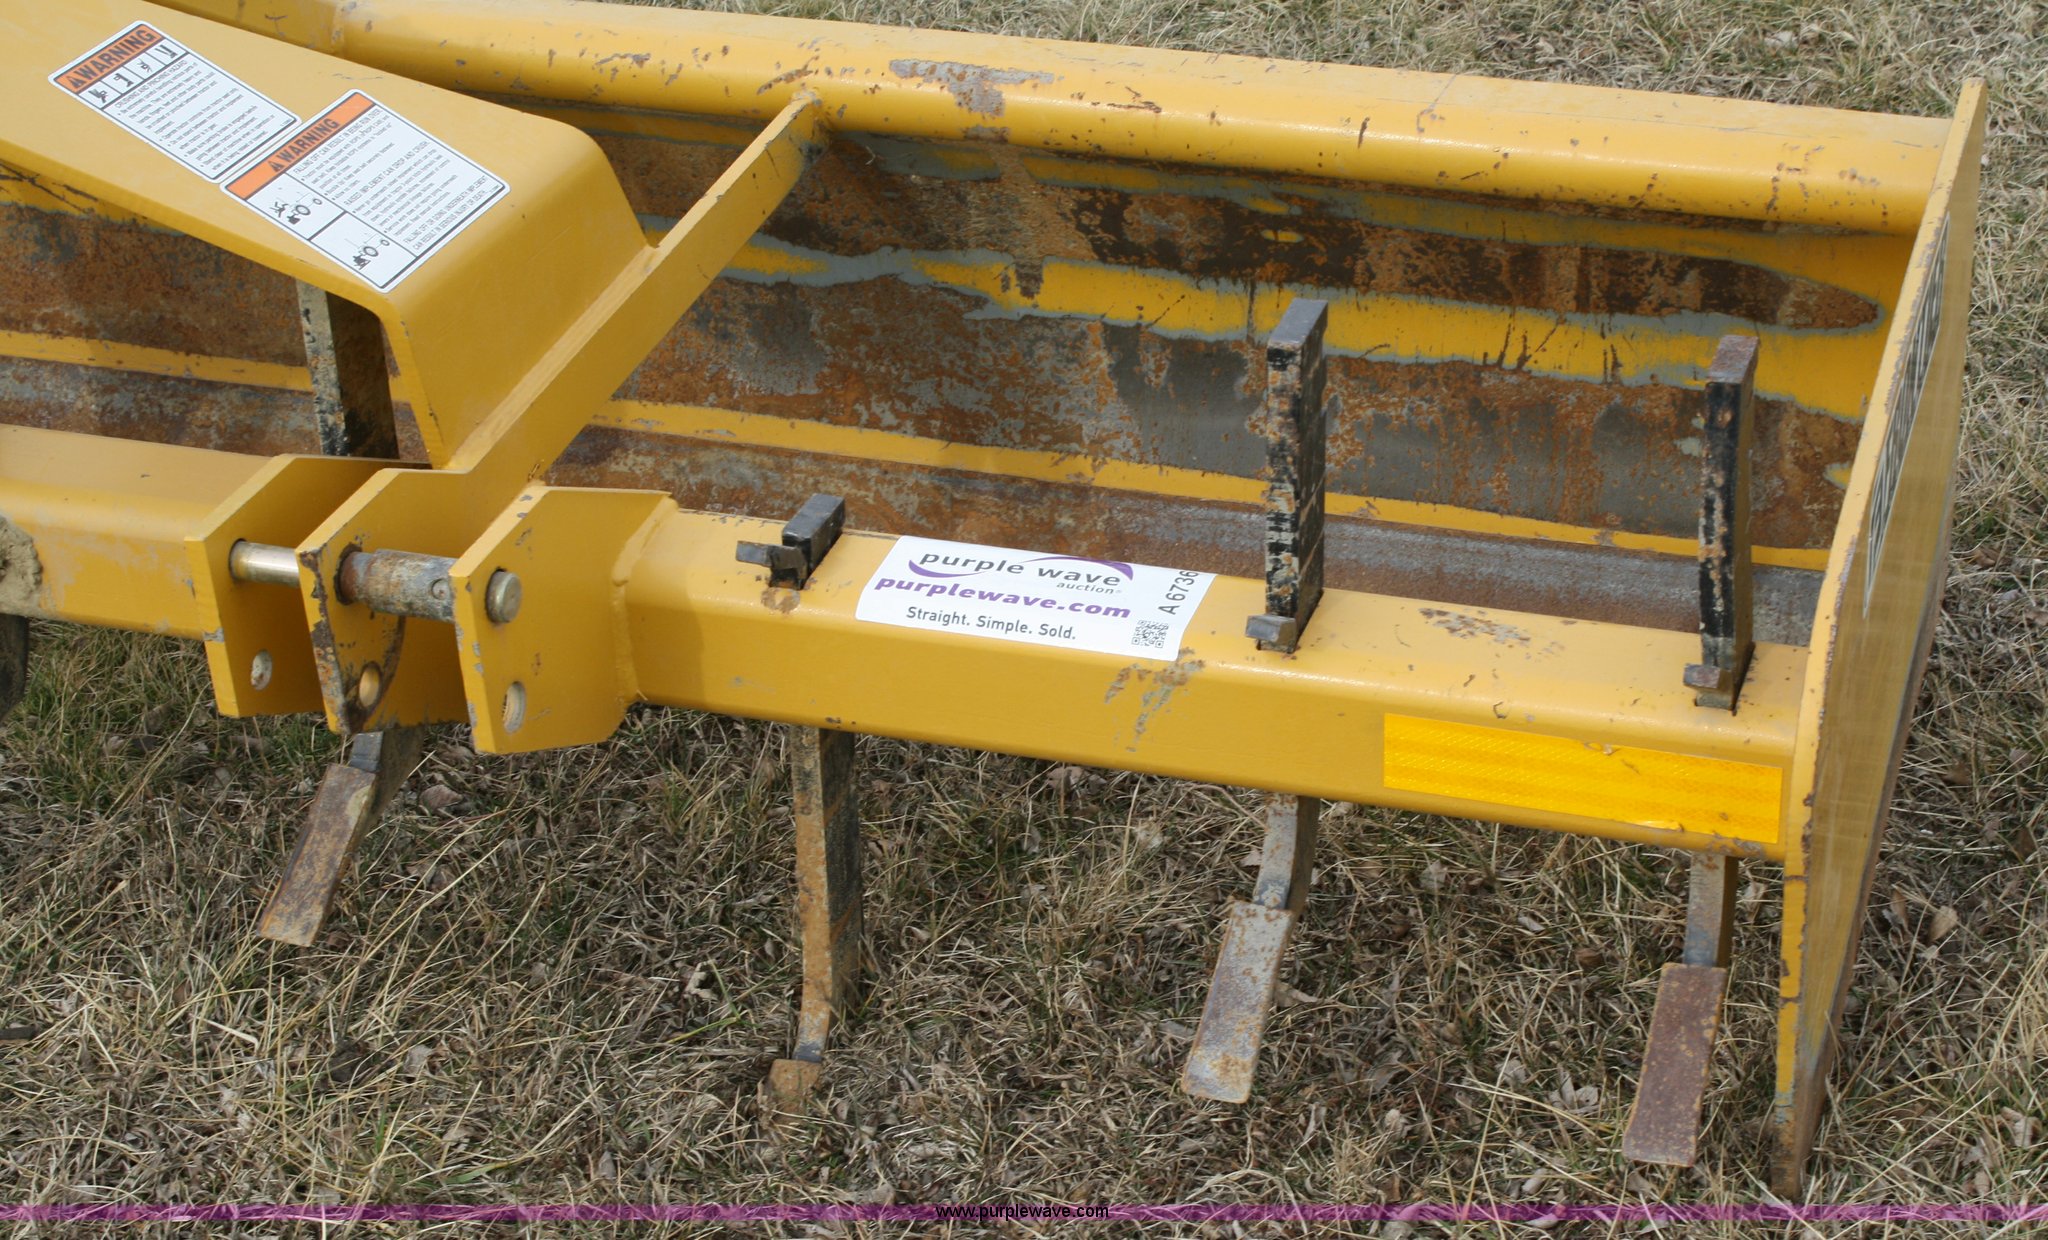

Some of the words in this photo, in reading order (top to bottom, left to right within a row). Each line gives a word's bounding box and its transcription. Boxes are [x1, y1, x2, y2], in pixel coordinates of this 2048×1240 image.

[72, 28, 157, 81] WARNING
[275, 116, 340, 164] WARNING
[919, 552, 1024, 575] purple
[1037, 566, 1121, 587] wave
[874, 576, 1131, 619] purplewave.com
[1056, 581, 1115, 595] auction
[906, 606, 971, 627] Straight.
[976, 615, 1032, 635] Simple.
[1040, 623, 1076, 640] Sold.
[1158, 604, 1179, 615] A
